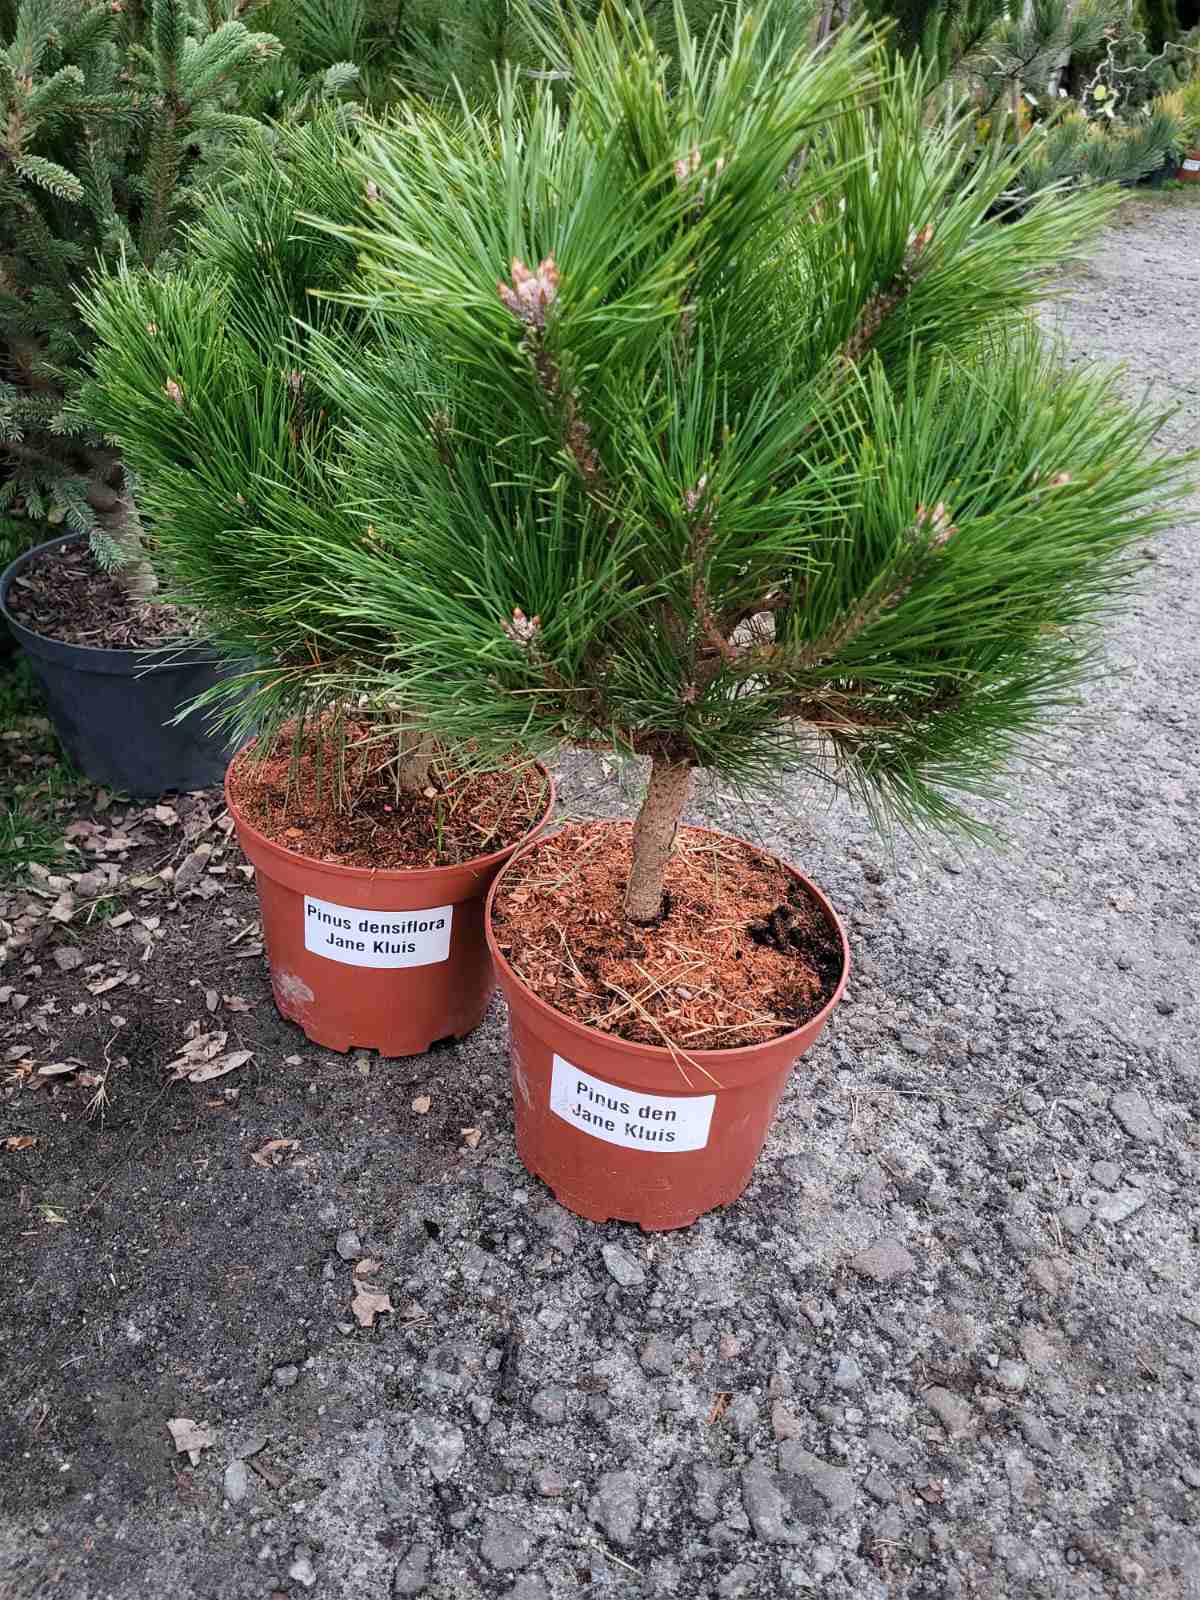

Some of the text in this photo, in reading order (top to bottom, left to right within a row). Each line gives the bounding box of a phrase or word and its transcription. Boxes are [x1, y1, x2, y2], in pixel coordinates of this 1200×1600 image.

[307, 903, 445, 935] Pinus densiflora
[325, 933, 416, 954] Jane Kluis
[576, 1080, 630, 1115] Pinus
[571, 1103, 676, 1143] Jane Kluis
